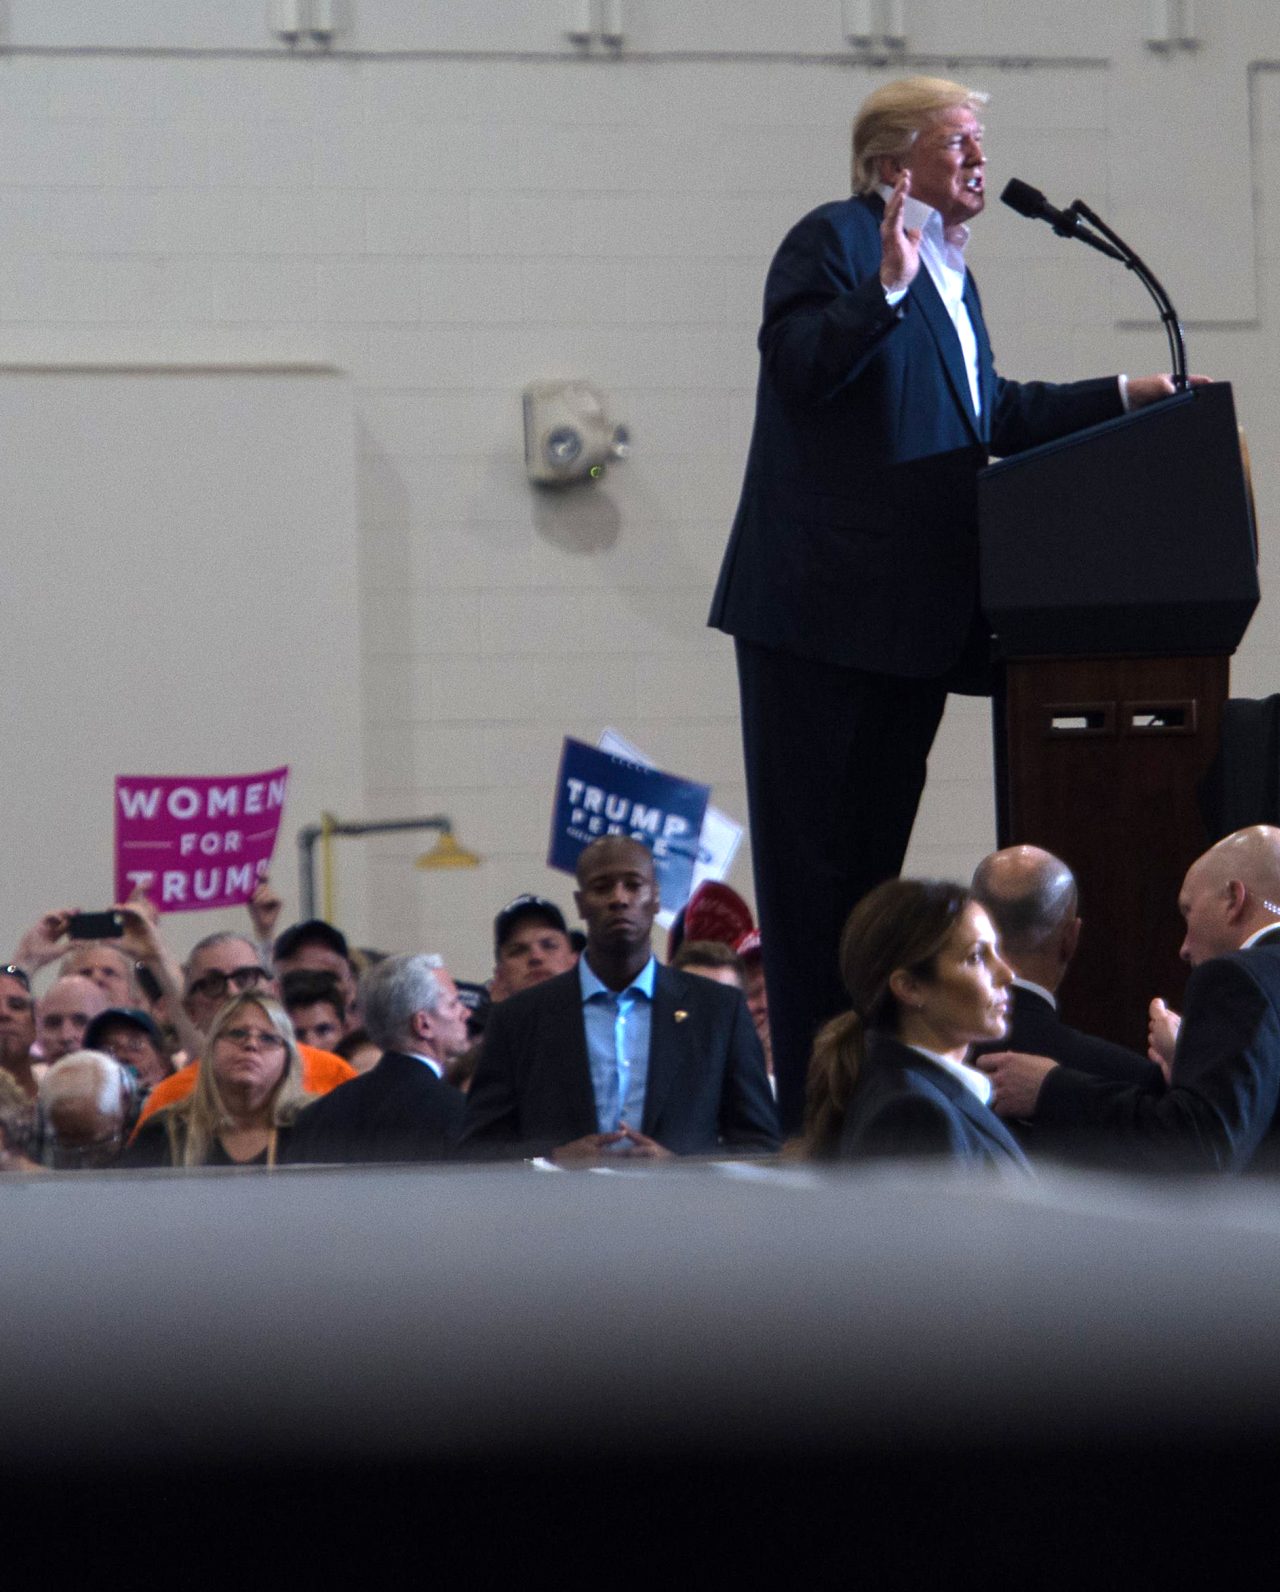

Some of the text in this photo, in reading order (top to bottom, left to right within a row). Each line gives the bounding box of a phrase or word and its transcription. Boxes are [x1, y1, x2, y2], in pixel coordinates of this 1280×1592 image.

[117, 776, 286, 820] WOMEN
[566, 777, 690, 839] TRUMP
[180, 830, 242, 857] FOR
